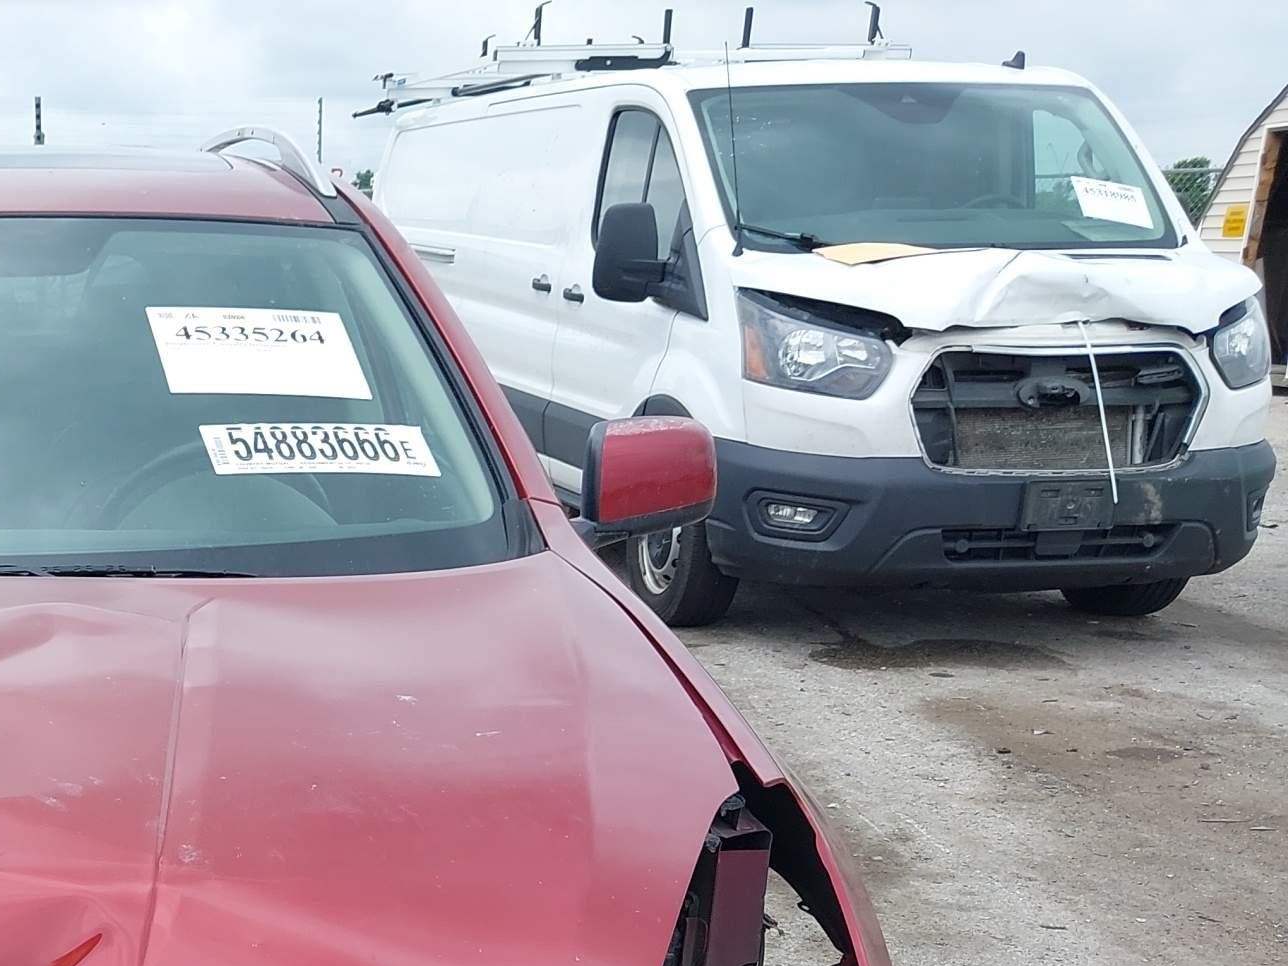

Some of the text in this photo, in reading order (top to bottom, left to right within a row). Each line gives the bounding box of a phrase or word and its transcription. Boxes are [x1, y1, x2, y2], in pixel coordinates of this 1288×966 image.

[175, 325, 326, 345] 45335264
[225, 426, 400, 462] 54883666
[400, 440, 417, 460] E
